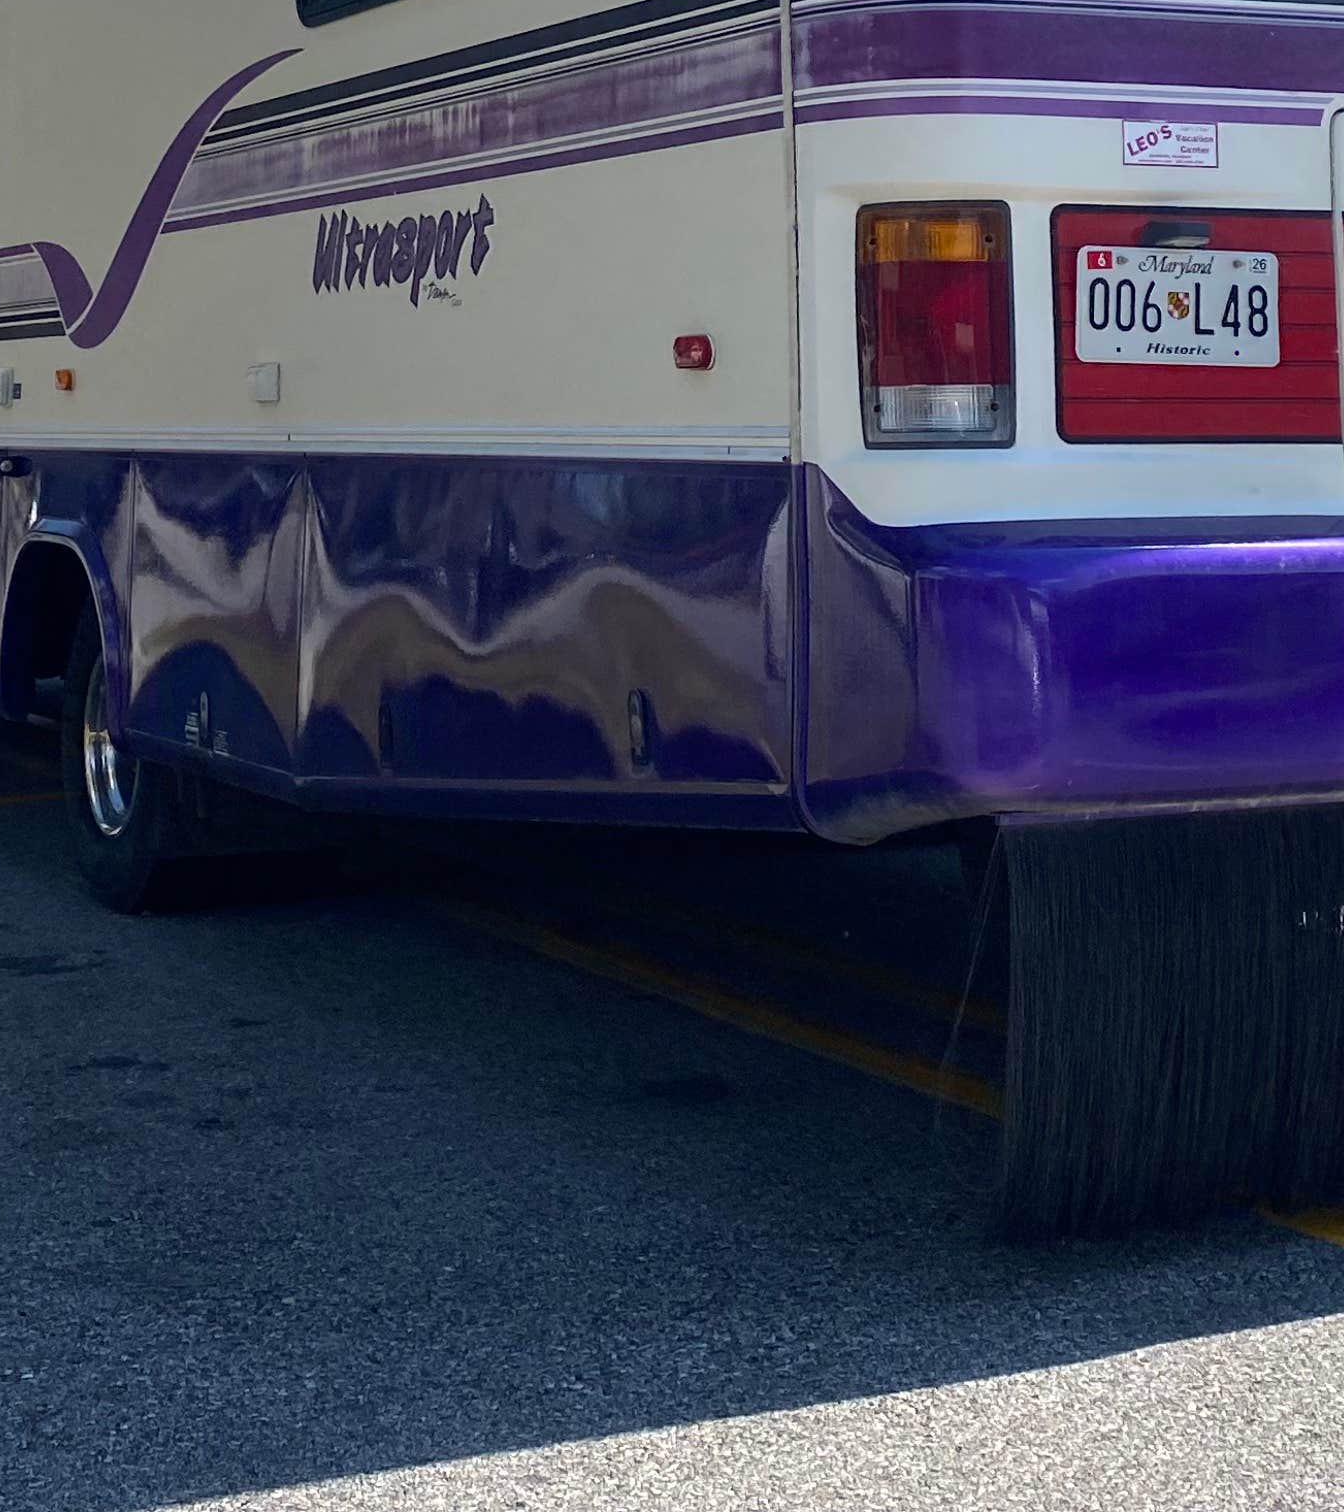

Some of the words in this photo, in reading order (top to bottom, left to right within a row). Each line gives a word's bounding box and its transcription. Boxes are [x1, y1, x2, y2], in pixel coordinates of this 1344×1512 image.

[1126, 124, 1173, 156] LEO'S
[312, 193, 494, 309] Ultrasport
[1138, 255, 1215, 279] Maryland
[1252, 258, 1267, 271] 26
[1089, 277, 1161, 333] 006
[1194, 282, 1268, 338] L48
[1146, 343, 1211, 356] Historic
